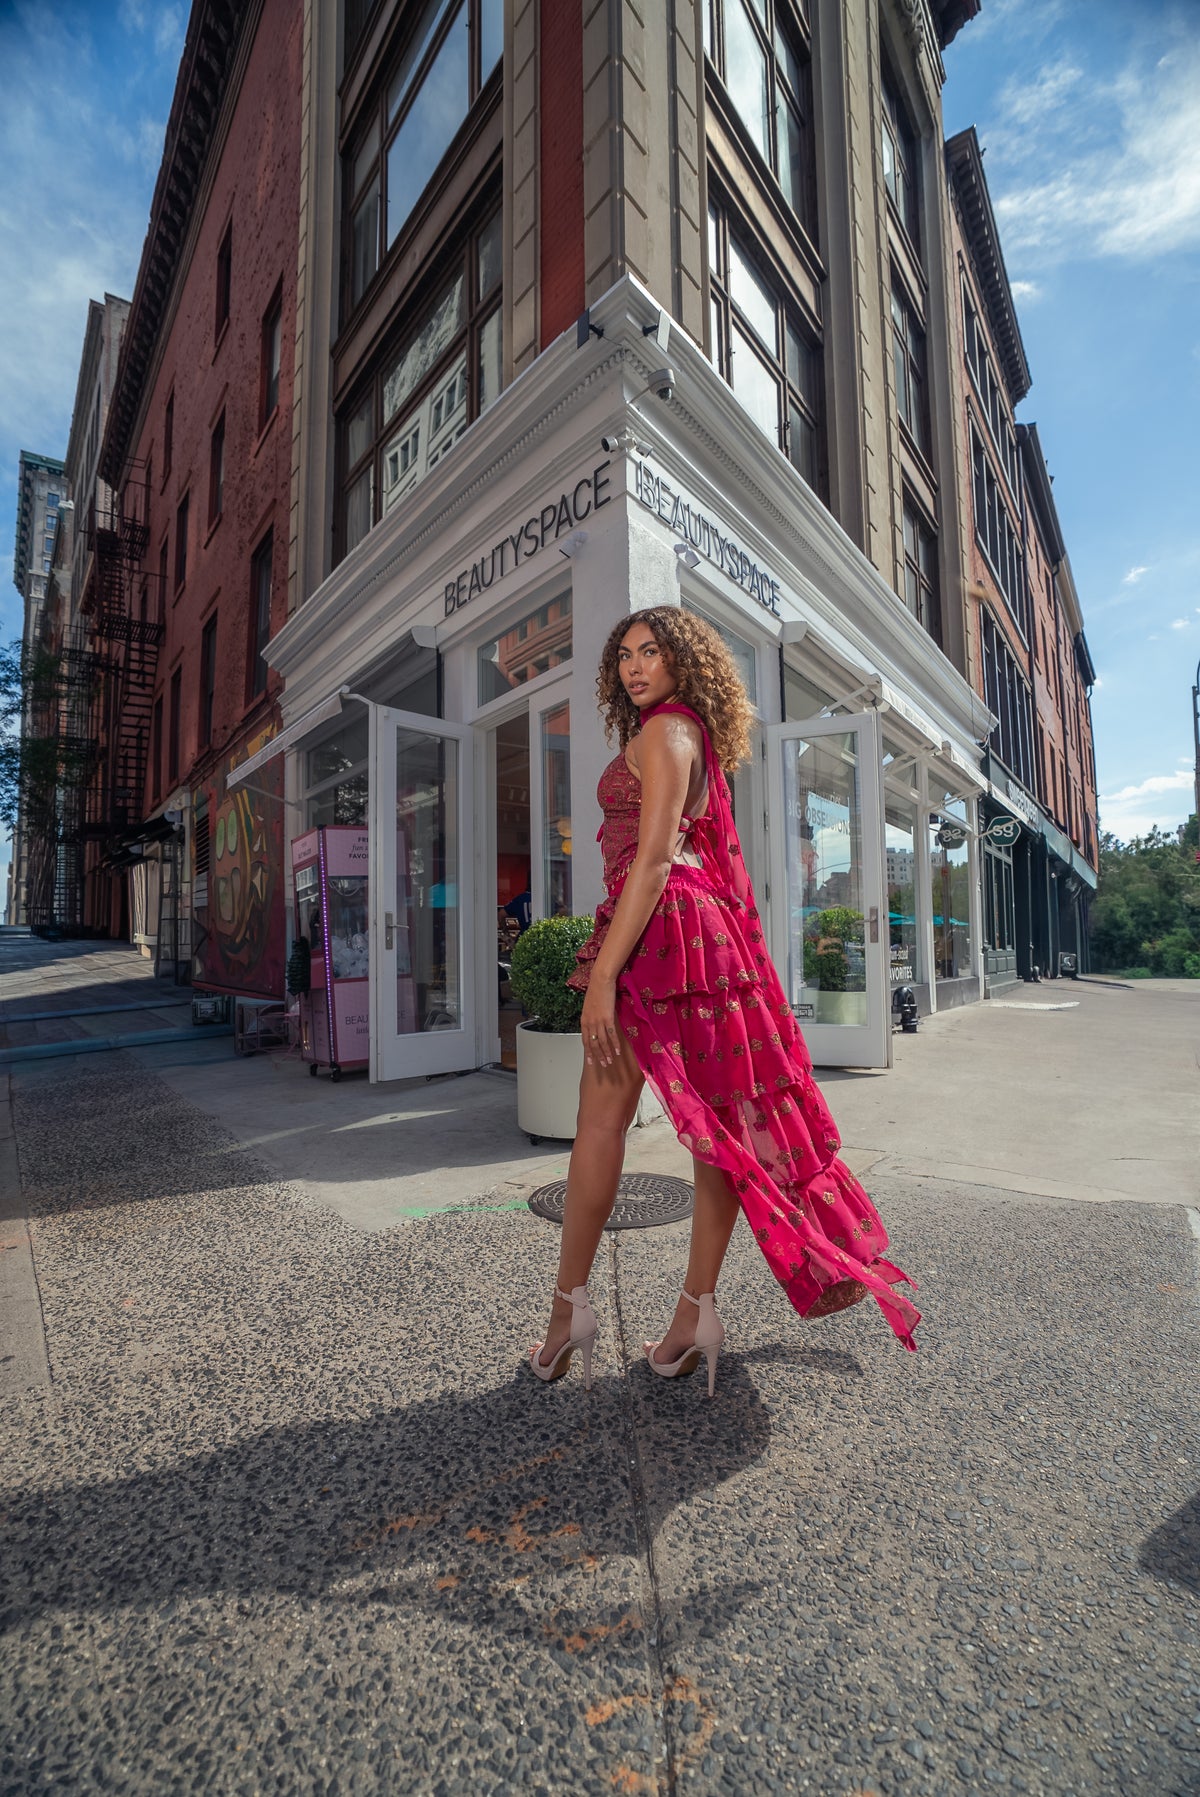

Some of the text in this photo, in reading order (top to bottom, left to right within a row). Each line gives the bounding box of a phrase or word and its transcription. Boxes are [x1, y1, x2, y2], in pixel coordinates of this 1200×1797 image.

[444, 460, 612, 618] BEAUTYSPACE
[638, 460, 782, 617] BEAUTYSPACE
[992, 824, 1014, 838] sg
